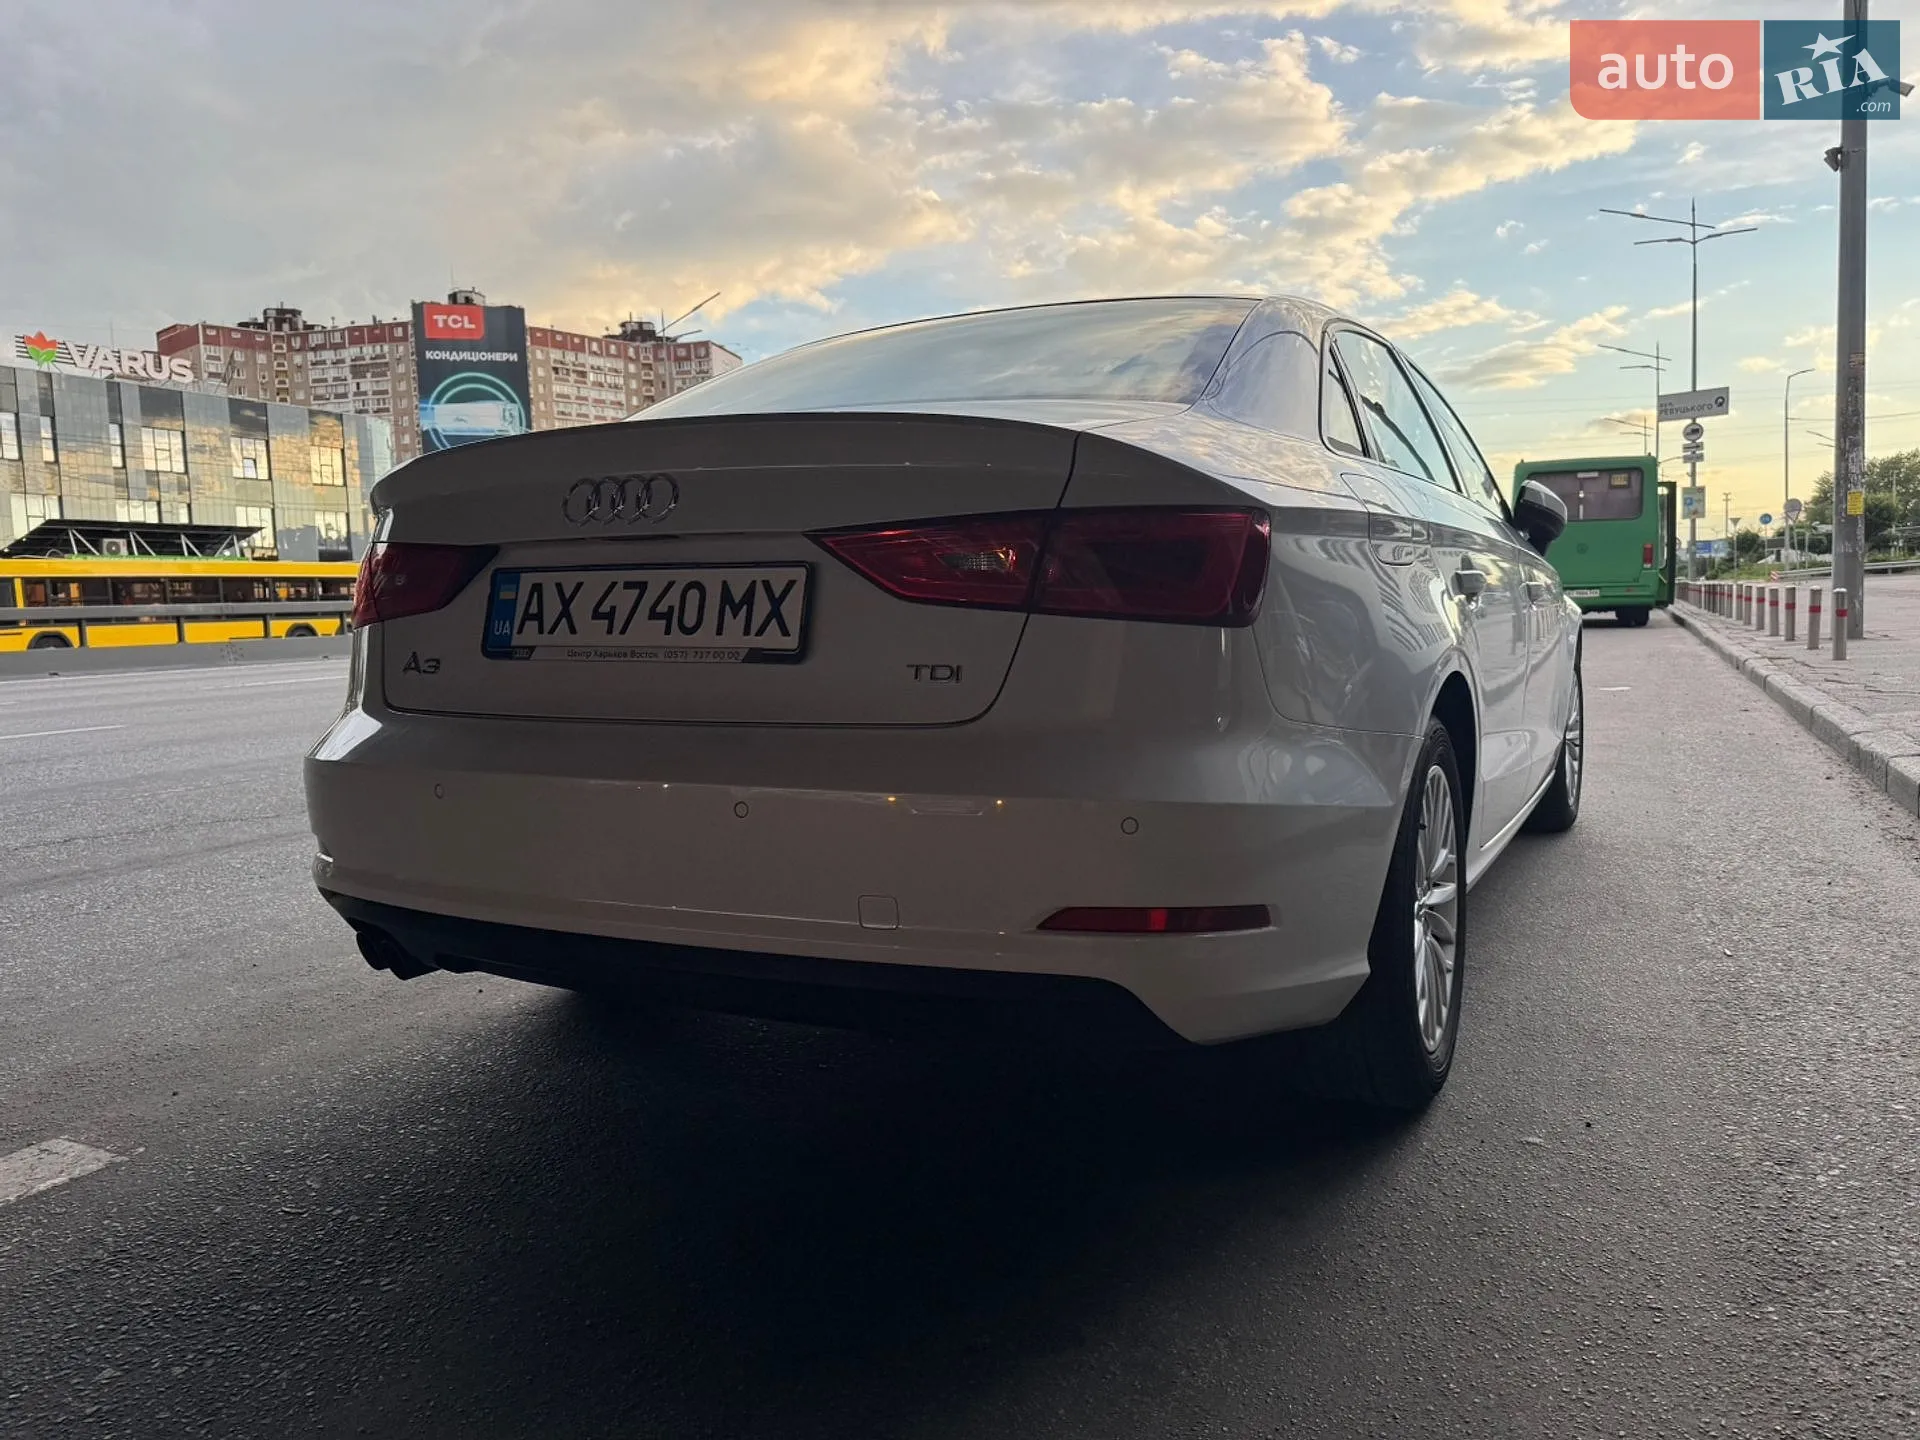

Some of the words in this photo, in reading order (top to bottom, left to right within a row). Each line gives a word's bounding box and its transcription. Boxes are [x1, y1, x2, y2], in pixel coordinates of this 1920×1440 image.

[432, 314, 476, 329] TCL
[63, 339, 194, 383] VARUS
[516, 580, 584, 636] AX
[591, 580, 707, 637] 4740
[715, 579, 798, 637] MX
[494, 619, 511, 636] UA
[402, 651, 441, 674] A3
[906, 664, 962, 684] TDI
